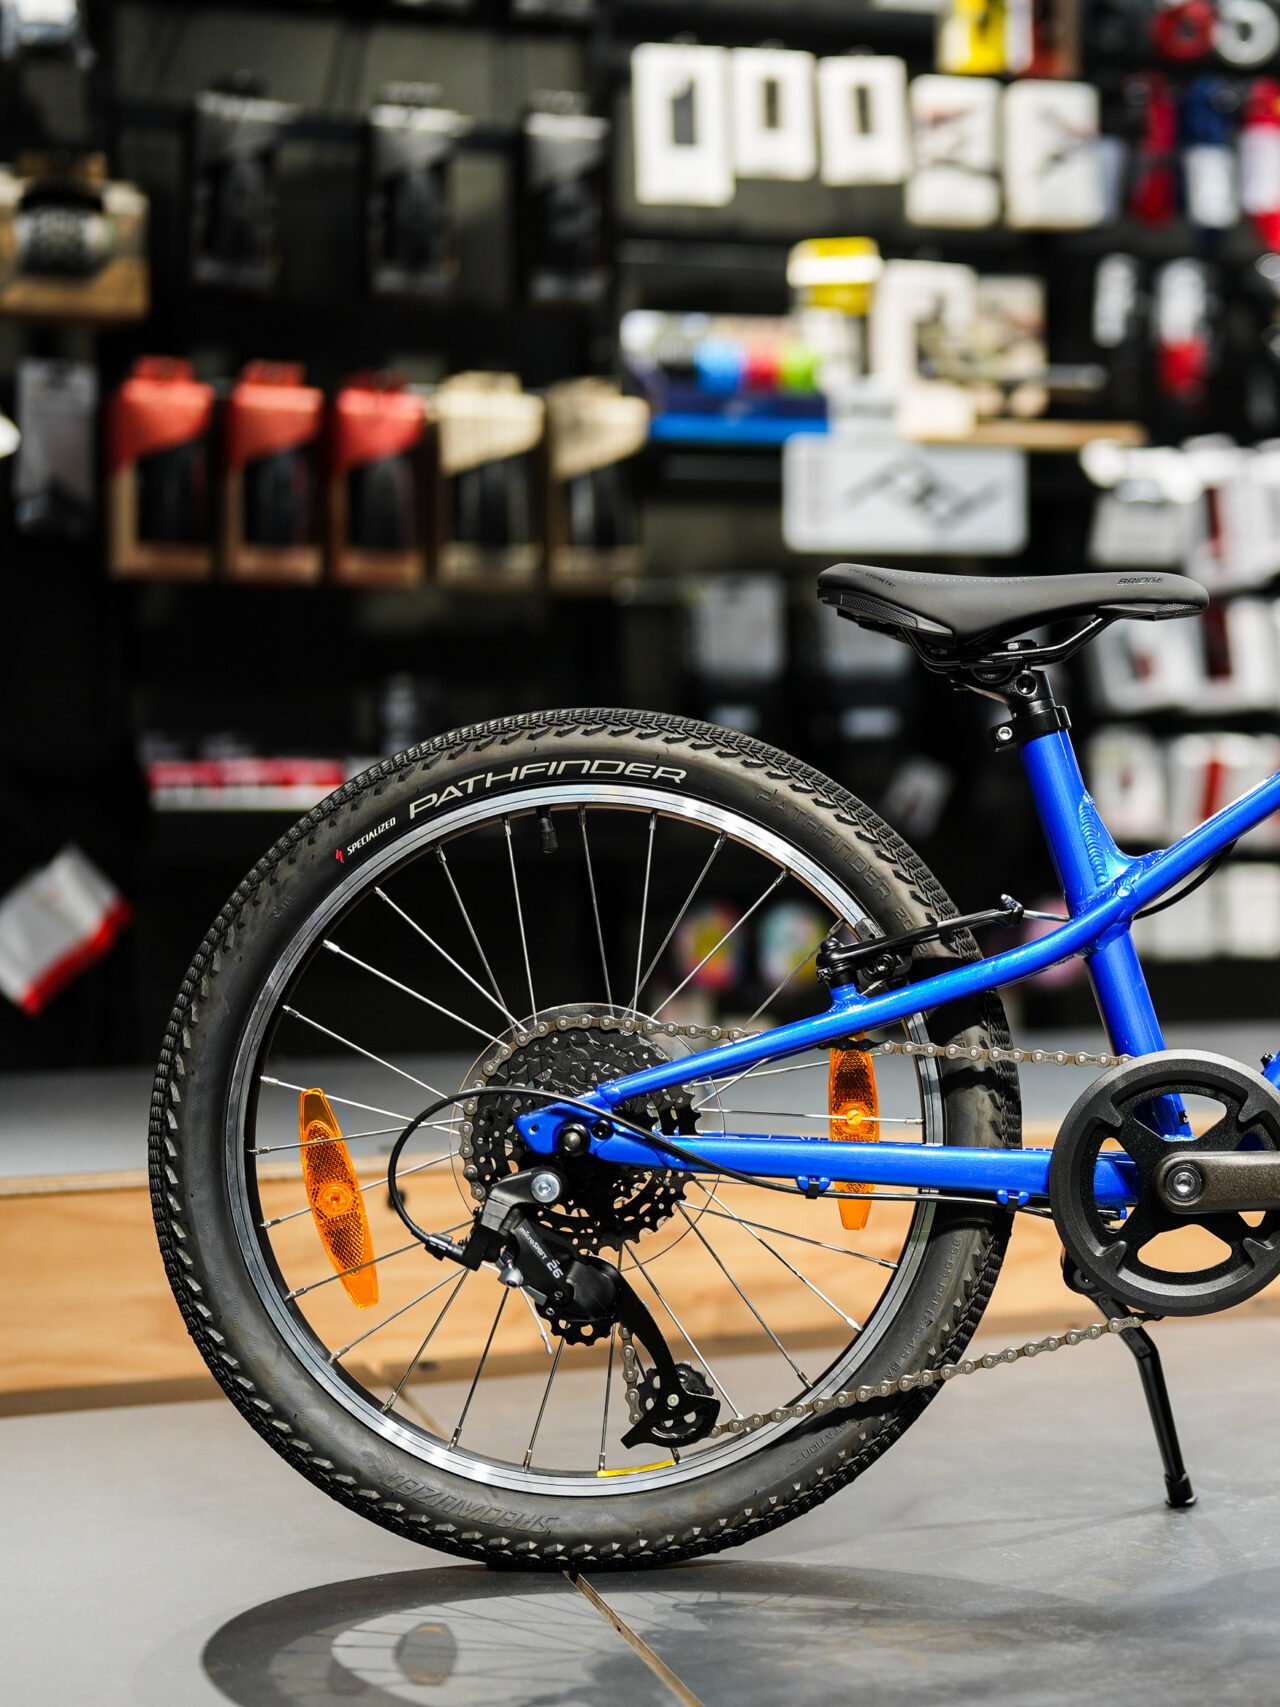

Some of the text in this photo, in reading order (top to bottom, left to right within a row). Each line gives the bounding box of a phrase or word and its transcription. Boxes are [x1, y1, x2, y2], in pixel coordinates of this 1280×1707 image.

[346, 759, 688, 856] SPECIALIZED PATHFINDER
[756, 788, 893, 900] PATHFINDER
[519, 1226, 564, 1279] microSHIFT 26
